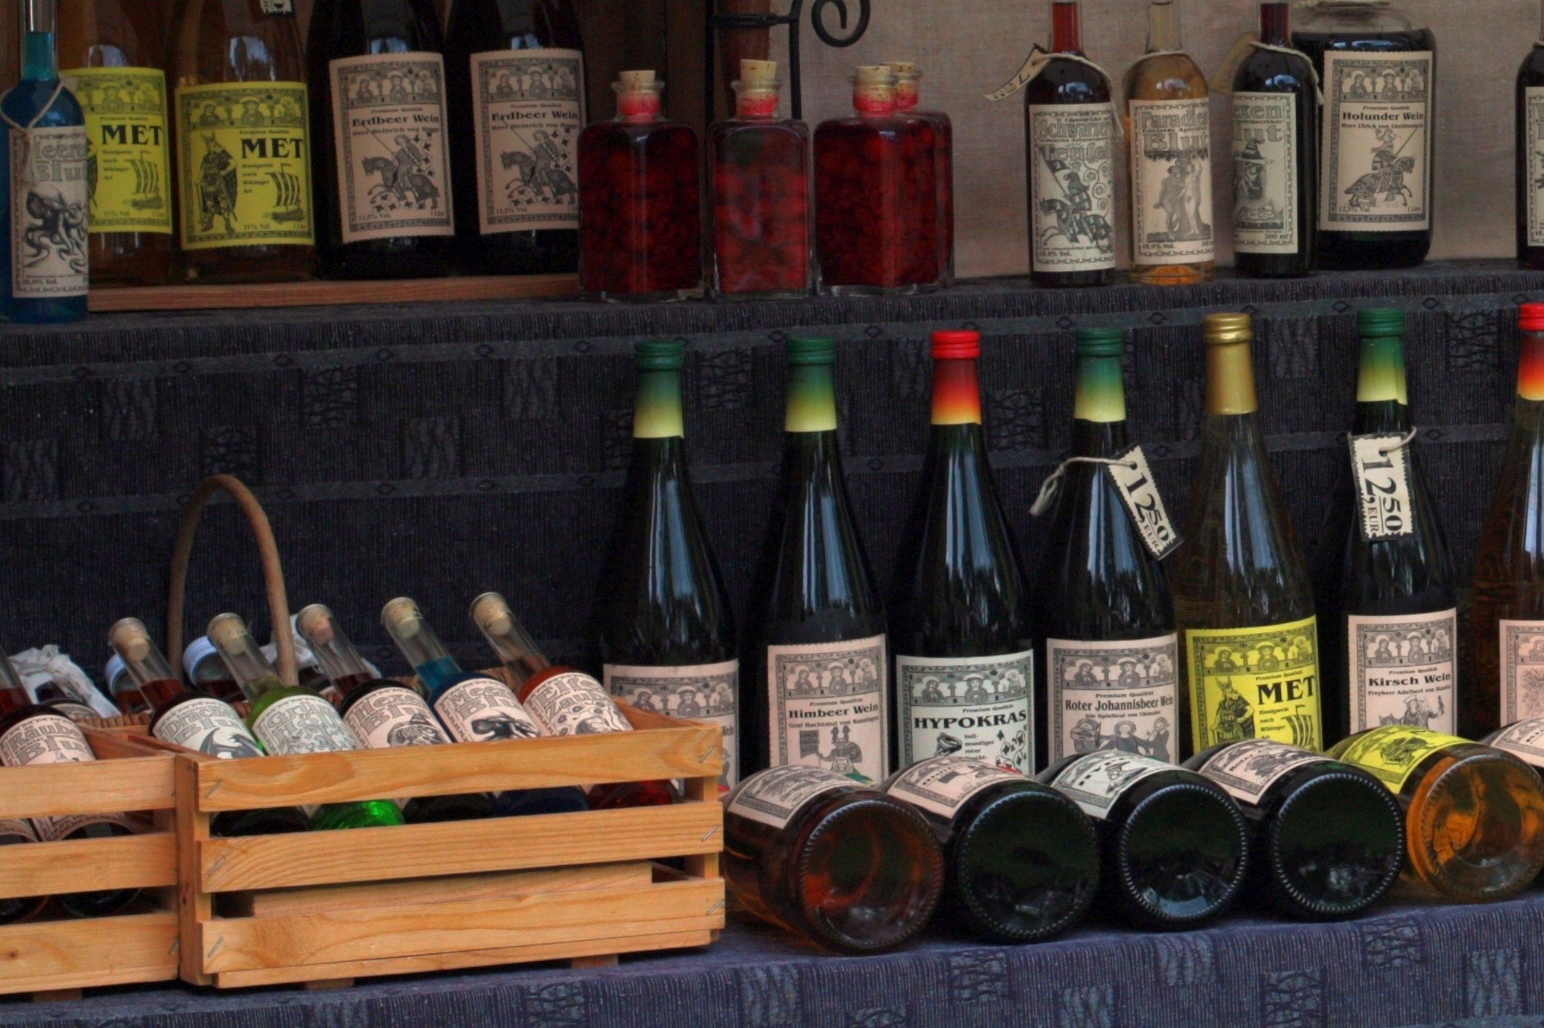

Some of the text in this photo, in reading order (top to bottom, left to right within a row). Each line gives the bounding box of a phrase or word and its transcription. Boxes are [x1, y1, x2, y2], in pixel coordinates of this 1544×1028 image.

[352, 114, 439, 127] Erdbeer Wein
[492, 110, 578, 121] Erdbeer Wein
[1234, 104, 1283, 119] xen
[1342, 112, 1424, 121] Holunder Wein
[100, 124, 162, 146] MET
[1235, 123, 1284, 144] lut
[240, 137, 303, 159] MET
[36, 162, 86, 182] Blu
[1368, 507, 1380, 533] EUR
[1368, 673, 1451, 687] Kirsch Wein
[1257, 676, 1315, 706] MET
[789, 703, 878, 719] Himbeer Wein
[1065, 694, 1174, 712] Roter Johannisbeer Wein
[914, 710, 1027, 729] HYPOKRAS
[21, 737, 83, 764] Blu
